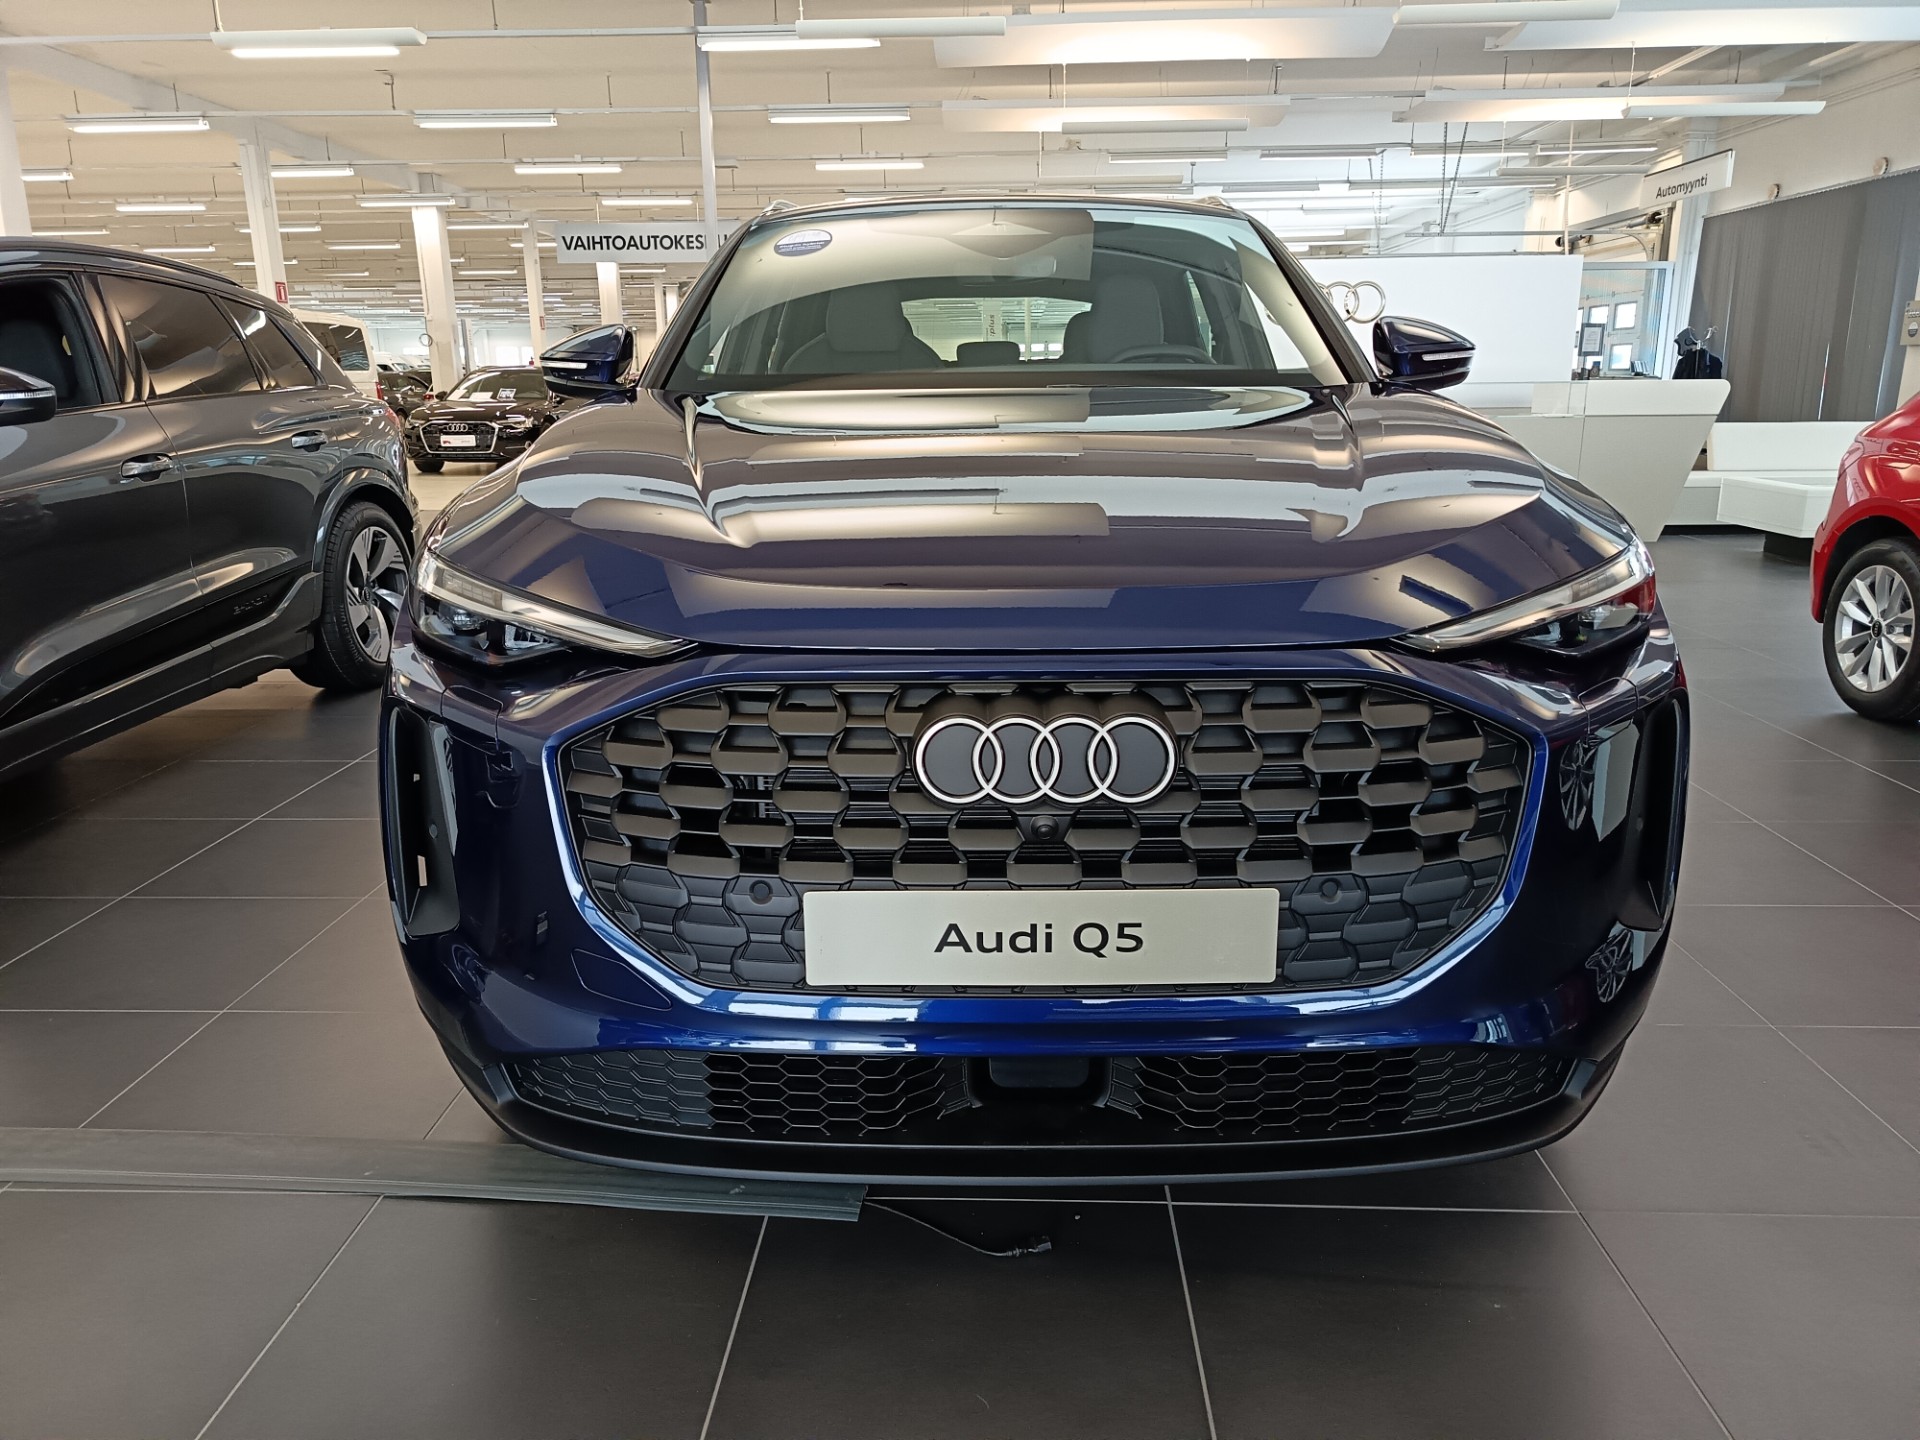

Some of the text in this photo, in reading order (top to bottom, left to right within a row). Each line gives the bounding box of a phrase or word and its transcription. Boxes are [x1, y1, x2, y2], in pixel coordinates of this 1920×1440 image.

[1655, 173, 1708, 199] Automyynti
[561, 234, 728, 251] VAIHTOAUTOKES
[934, 922, 1145, 958] Audi Q5
